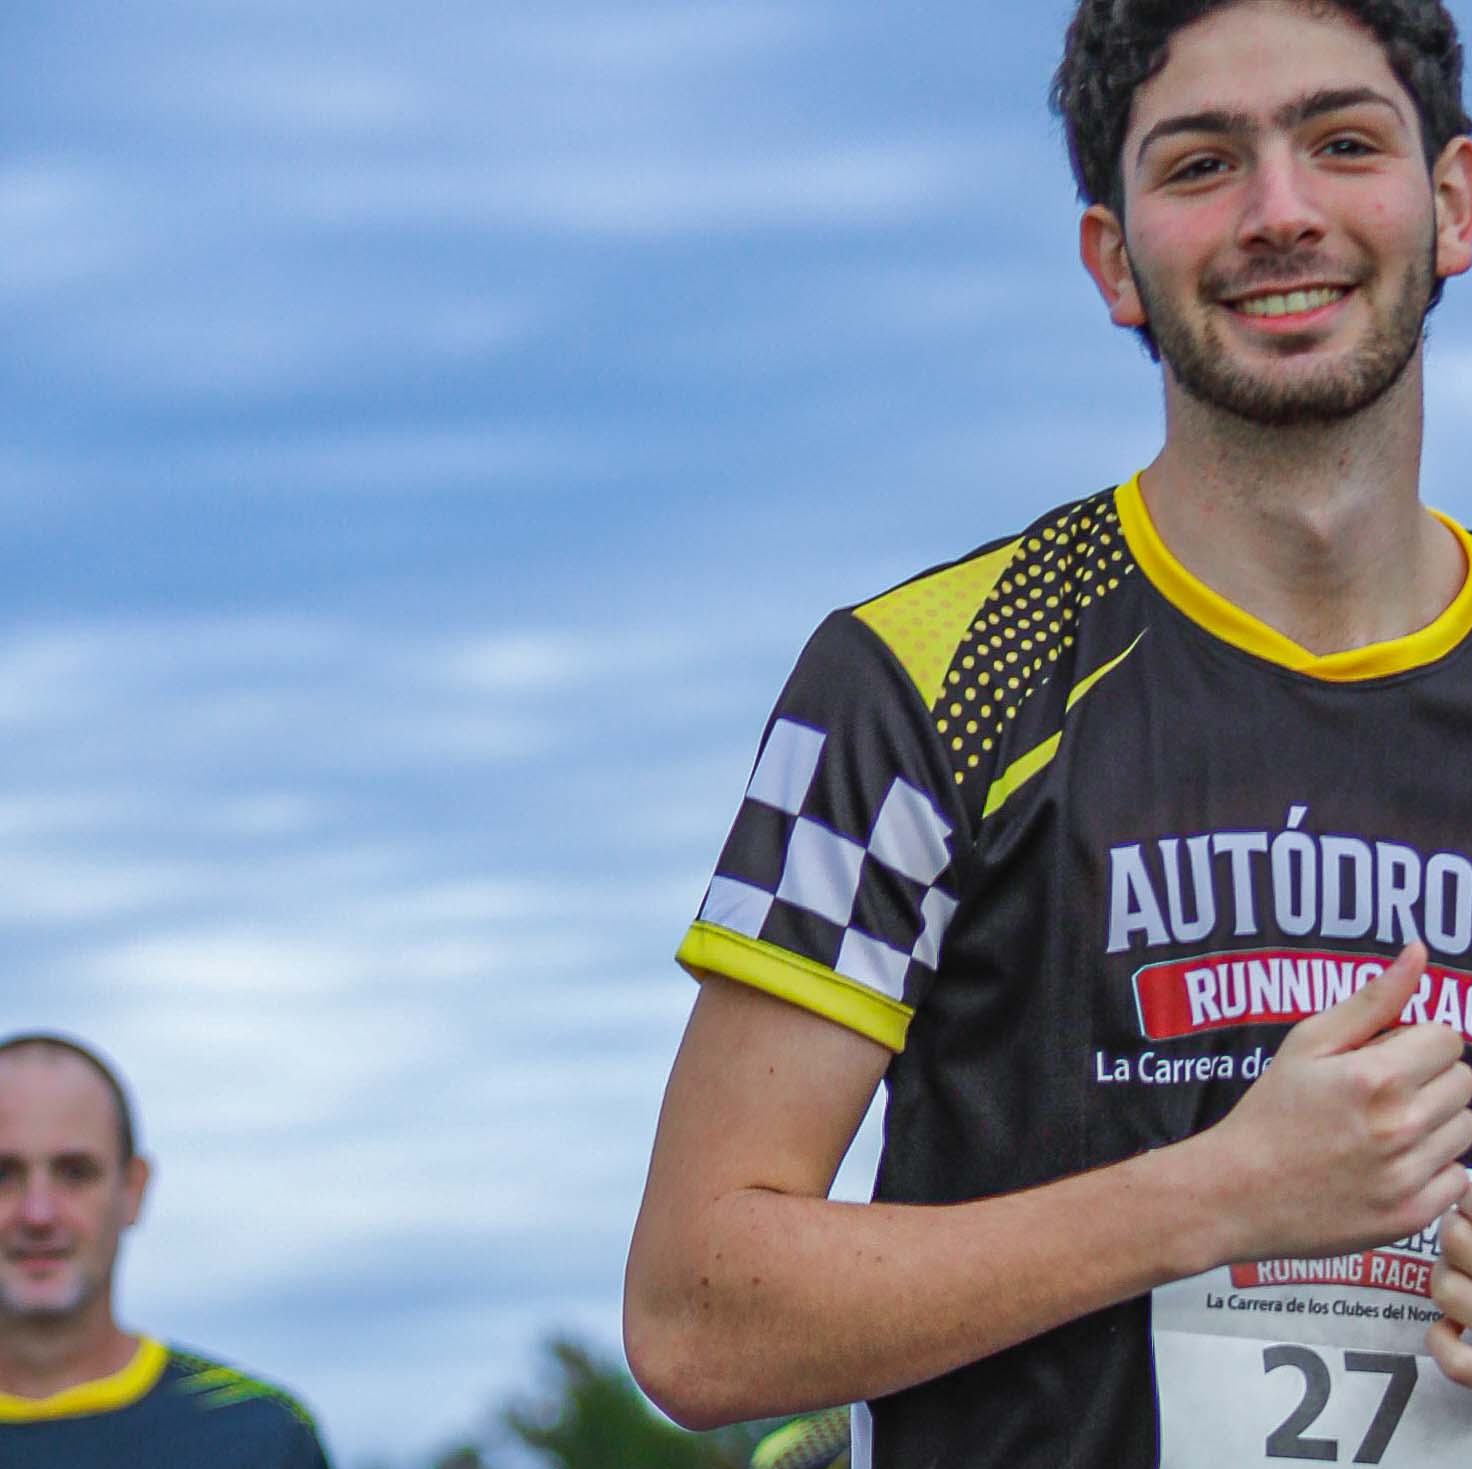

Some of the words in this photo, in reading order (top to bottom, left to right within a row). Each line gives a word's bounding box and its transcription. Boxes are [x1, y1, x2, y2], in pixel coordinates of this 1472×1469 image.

[1096, 1050, 1131, 1083] La
[1137, 1051, 1234, 1084] Carrera
[1256, 1253, 1364, 1284] RUNNING
[1370, 1255, 1428, 1294] RACE
[1206, 1293, 1223, 1309] La
[1227, 1294, 1283, 1313] Carrera
[1286, 1296, 1305, 1313] de
[1308, 1298, 1329, 1316] los
[1332, 1299, 1379, 1319] Clubes
[1382, 1302, 1404, 1321] del
[1408, 1306, 1444, 1323] Noro
[1262, 1343, 1419, 1466] 27
